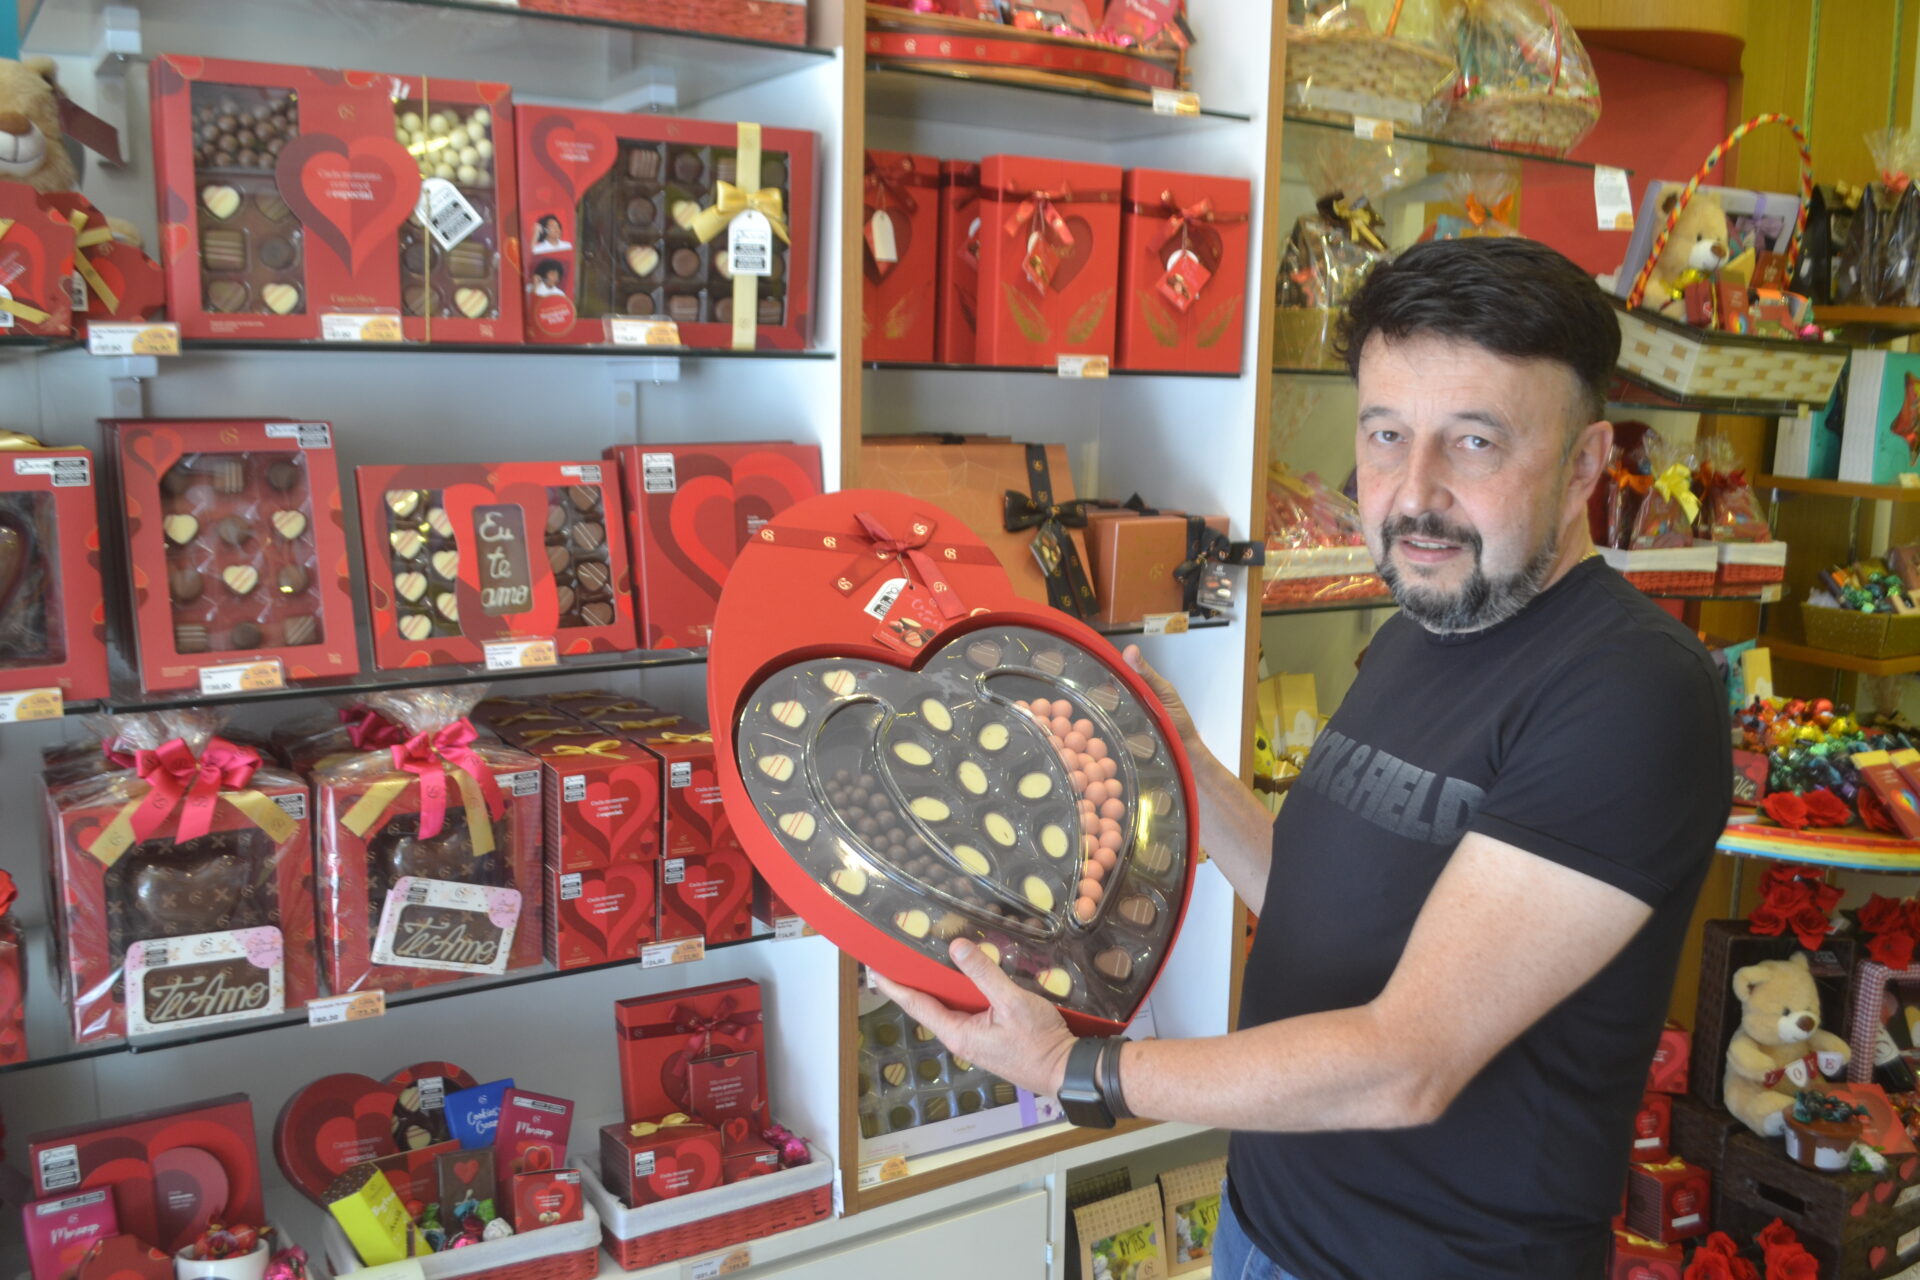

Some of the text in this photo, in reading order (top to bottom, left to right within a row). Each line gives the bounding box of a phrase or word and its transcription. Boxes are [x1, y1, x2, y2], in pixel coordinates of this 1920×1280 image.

[479, 512, 515, 541] Eu
[487, 546, 512, 578] te
[481, 585, 529, 607] amo
[404, 917, 498, 964] Te Amo
[150, 973, 268, 1023] Te Amo
